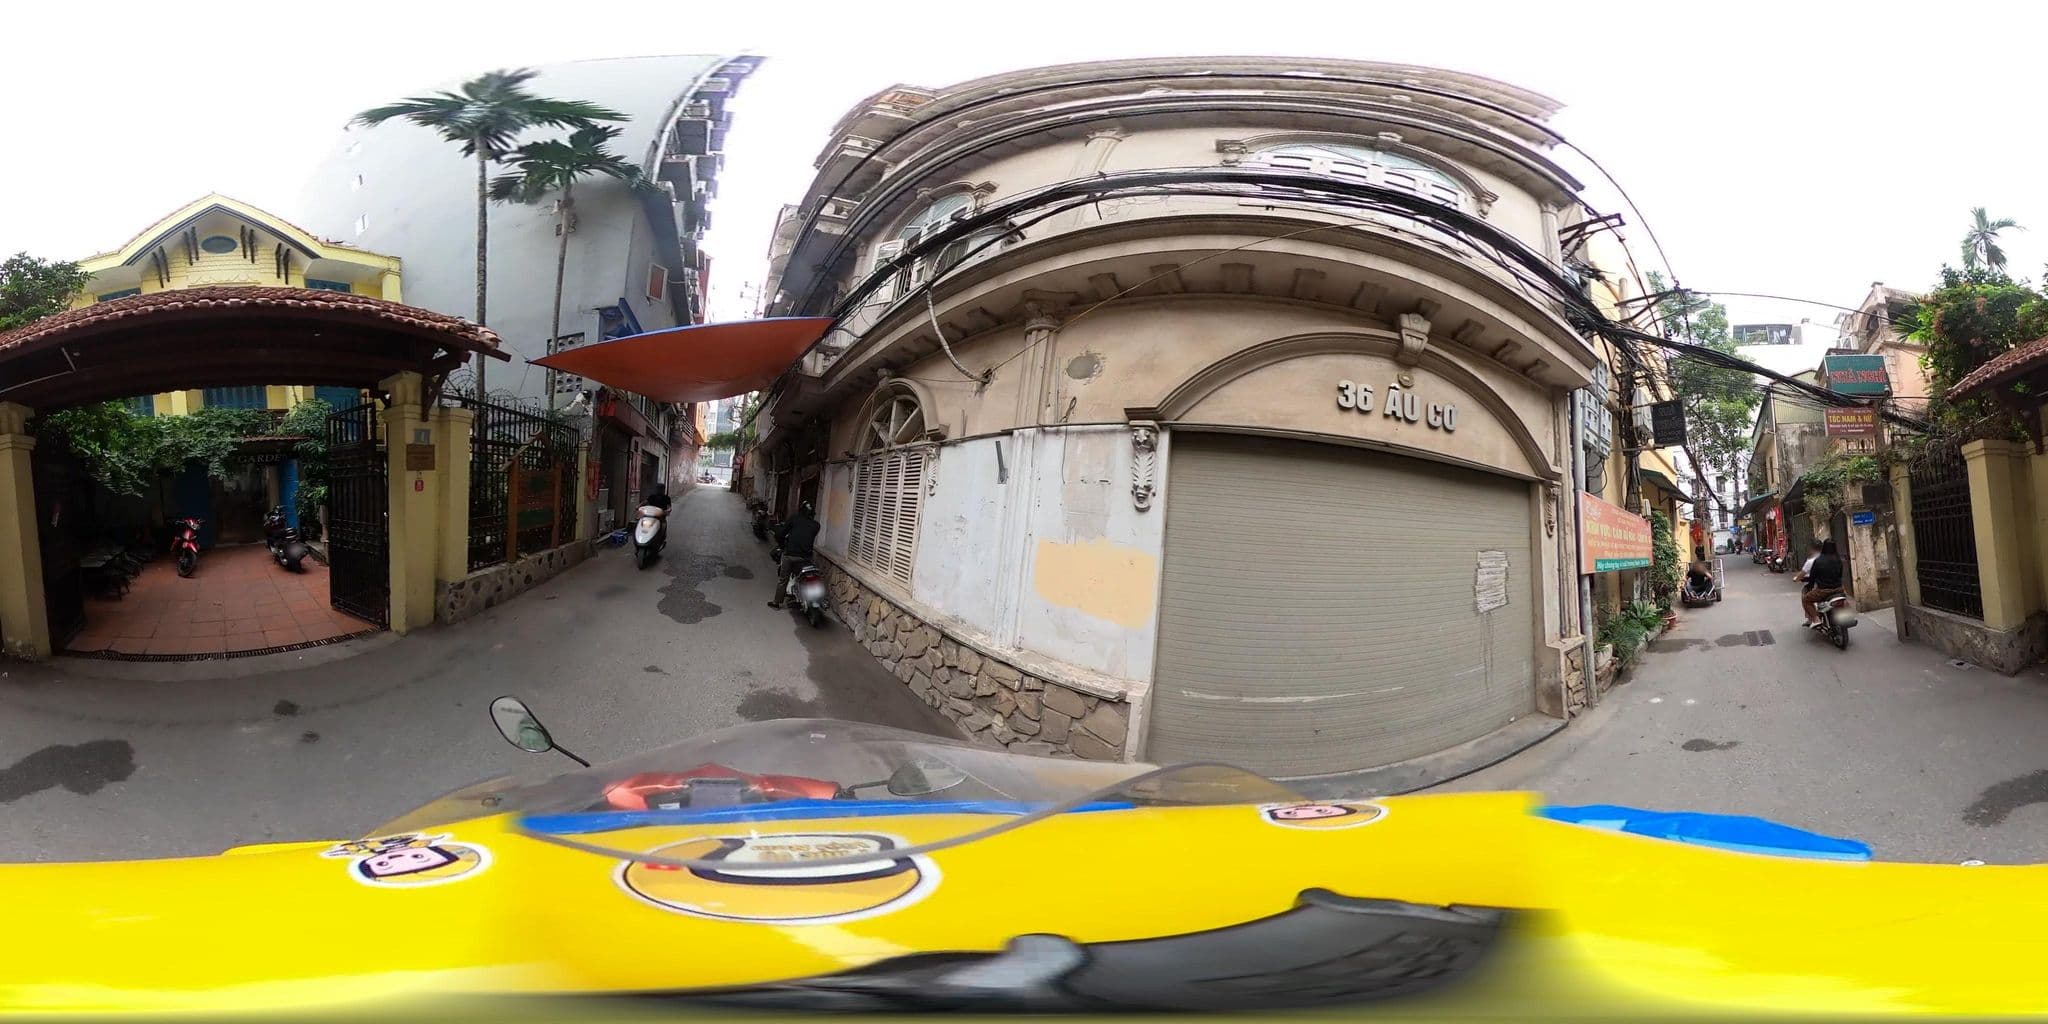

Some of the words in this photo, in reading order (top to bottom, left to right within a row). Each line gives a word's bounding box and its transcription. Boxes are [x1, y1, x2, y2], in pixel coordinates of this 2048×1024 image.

[1337, 379, 1374, 412] 36
[1383, 383, 1421, 421] ÂU
[1427, 401, 1458, 431] CƠ
